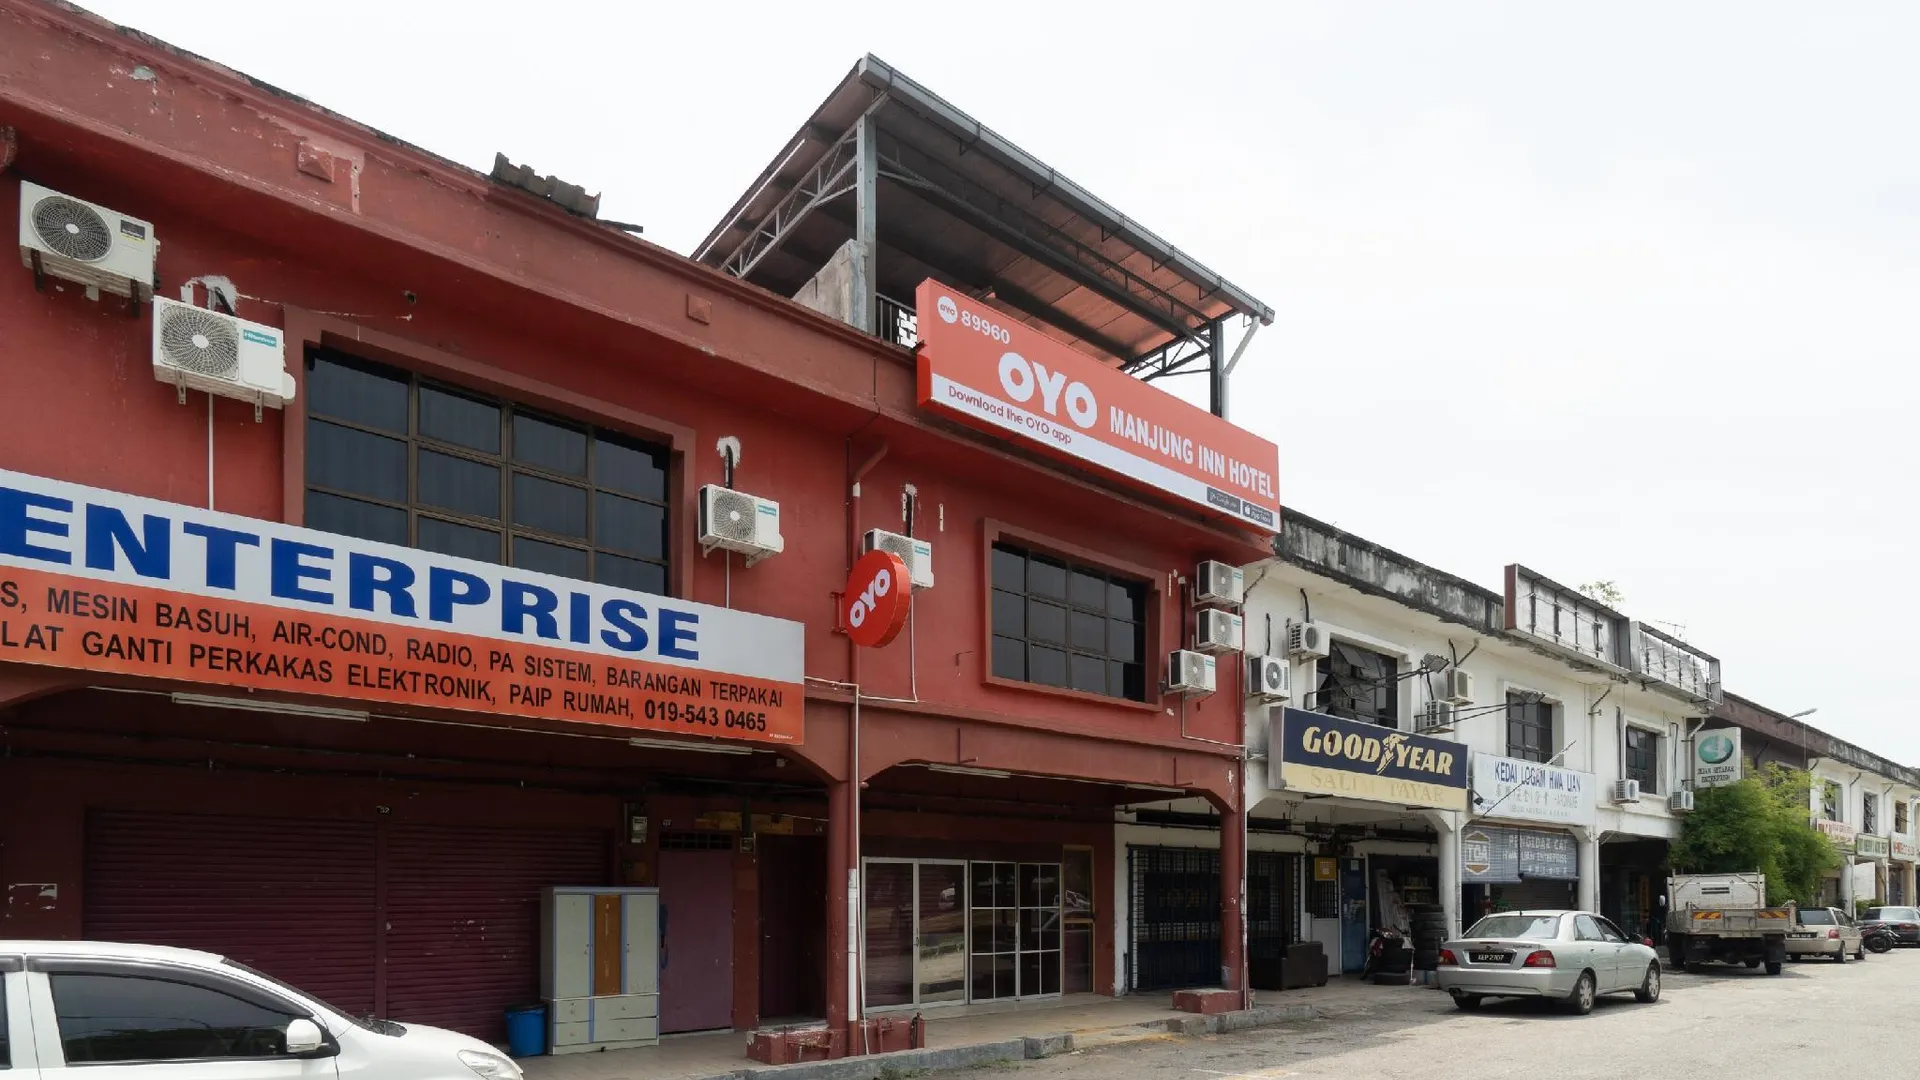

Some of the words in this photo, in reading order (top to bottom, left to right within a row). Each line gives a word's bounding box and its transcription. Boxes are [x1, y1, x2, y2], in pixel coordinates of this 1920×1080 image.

[961, 310, 1010, 344] 89960
[949, 385, 1004, 417] Download
[1006, 408, 1024, 425] the
[1026, 417, 1050, 435] OYO
[1052, 428, 1072, 445] app
[998, 352, 1098, 428] OYO
[1110, 405, 1194, 465] MANJUNG
[1198, 444, 1226, 479] INN
[1229, 458, 1275, 499] HOTEL
[0, 486, 700, 661] ENTERPRISE
[849, 568, 891, 628] OYO
[1, 620, 64, 652] LAT
[82, 630, 172, 666] GANTI
[189, 643, 333, 684] PERKAKAS
[347, 664, 497, 706] ELEKTRONIK,
[509, 683, 553, 709] PAIP
[563, 690, 635, 721] RUMAH,
[644, 700, 720, 728] 019-543
[725, 708, 767, 732] 0465
[47, 586, 138, 624] MESIN
[155, 602, 257, 643] BASUH,
[272, 619, 394, 662] AIR-COND,
[406, 638, 477, 673] RADIO,
[490, 650, 515, 674] PA
[524, 655, 597, 687] SISTEM,
[606, 666, 701, 698] BARANGAN
[710, 680, 783, 708] TERPAKAI
[1494, 760, 1518, 784] KEDAI
[1520, 764, 1546, 789] LOGAM
